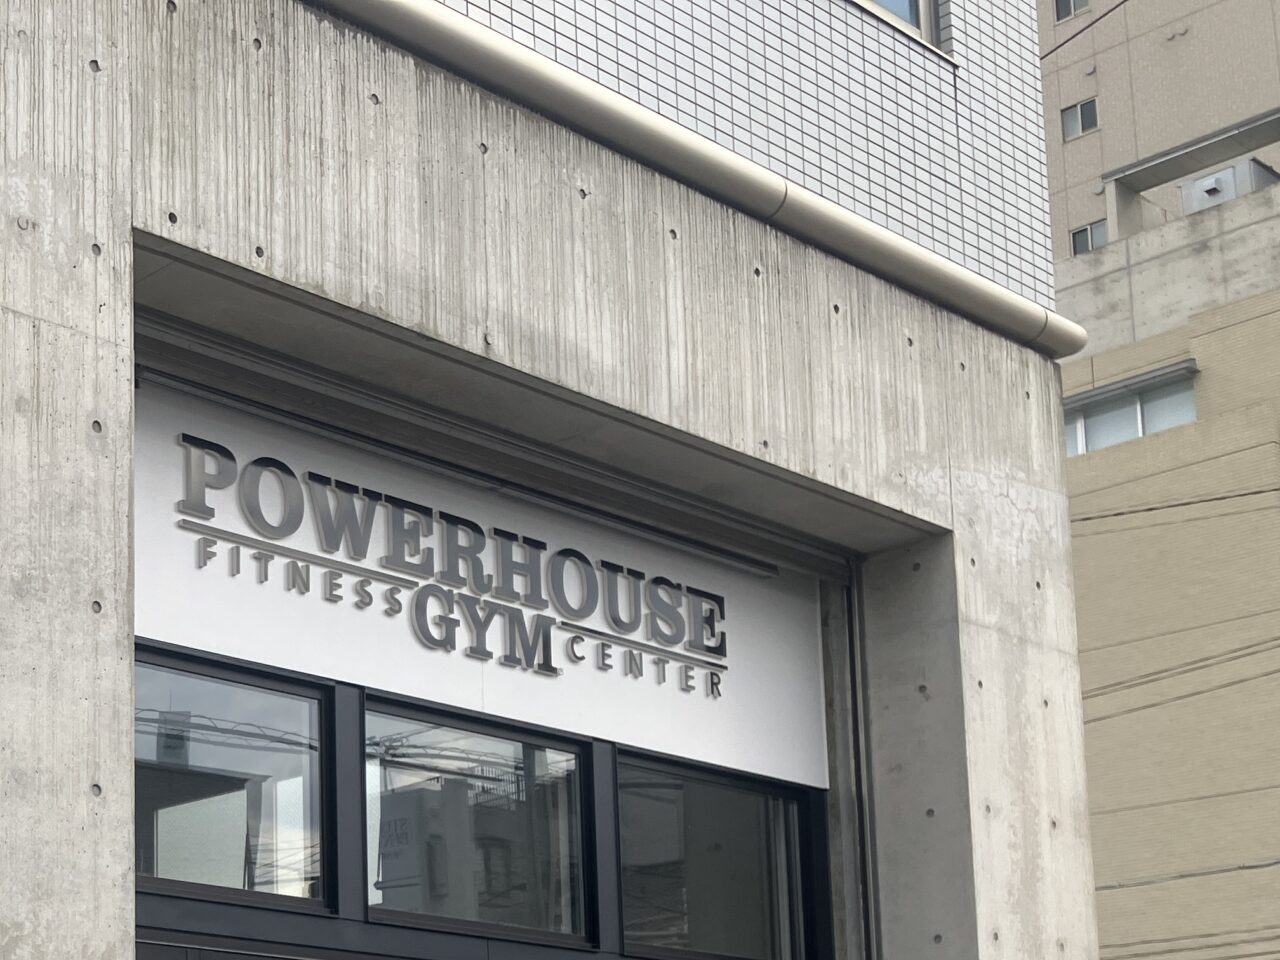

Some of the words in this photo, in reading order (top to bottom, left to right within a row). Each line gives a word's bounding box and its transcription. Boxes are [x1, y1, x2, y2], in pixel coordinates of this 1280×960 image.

[176, 432, 728, 659] POWERHOUSE
[196, 536, 403, 617] FITNESS
[411, 582, 559, 677] GYM
[567, 634, 722, 698] CENTER
